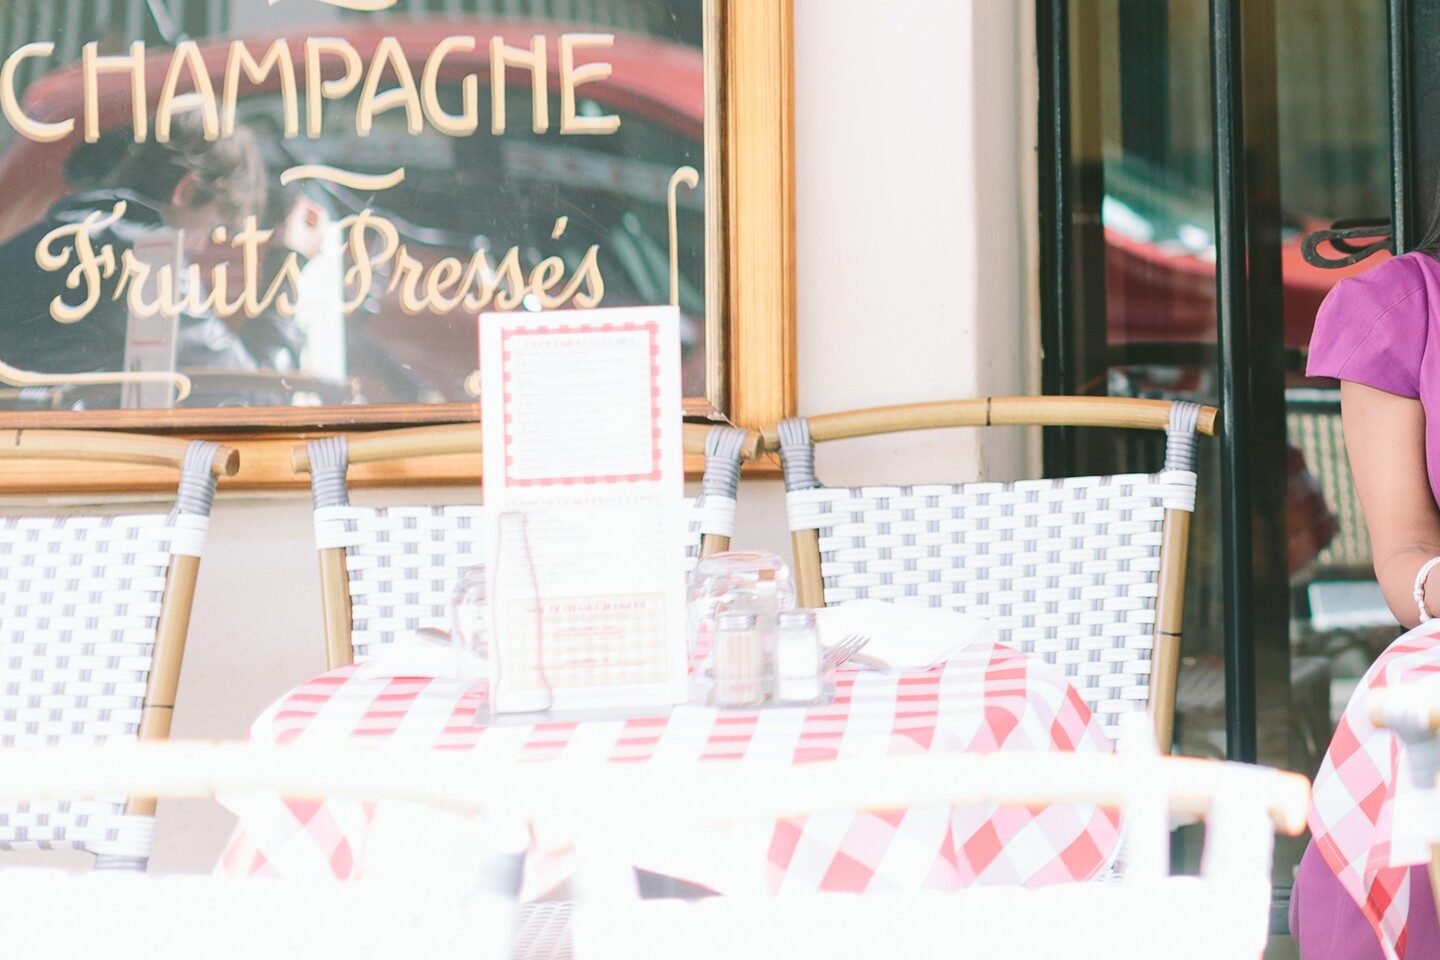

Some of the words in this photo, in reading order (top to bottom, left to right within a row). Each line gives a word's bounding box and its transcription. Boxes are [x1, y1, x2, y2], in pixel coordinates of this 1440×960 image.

[0, 33, 621, 143] CHAMPAGNE
[35, 200, 303, 323] Fruits
[342, 208, 605, 318] Pressés
